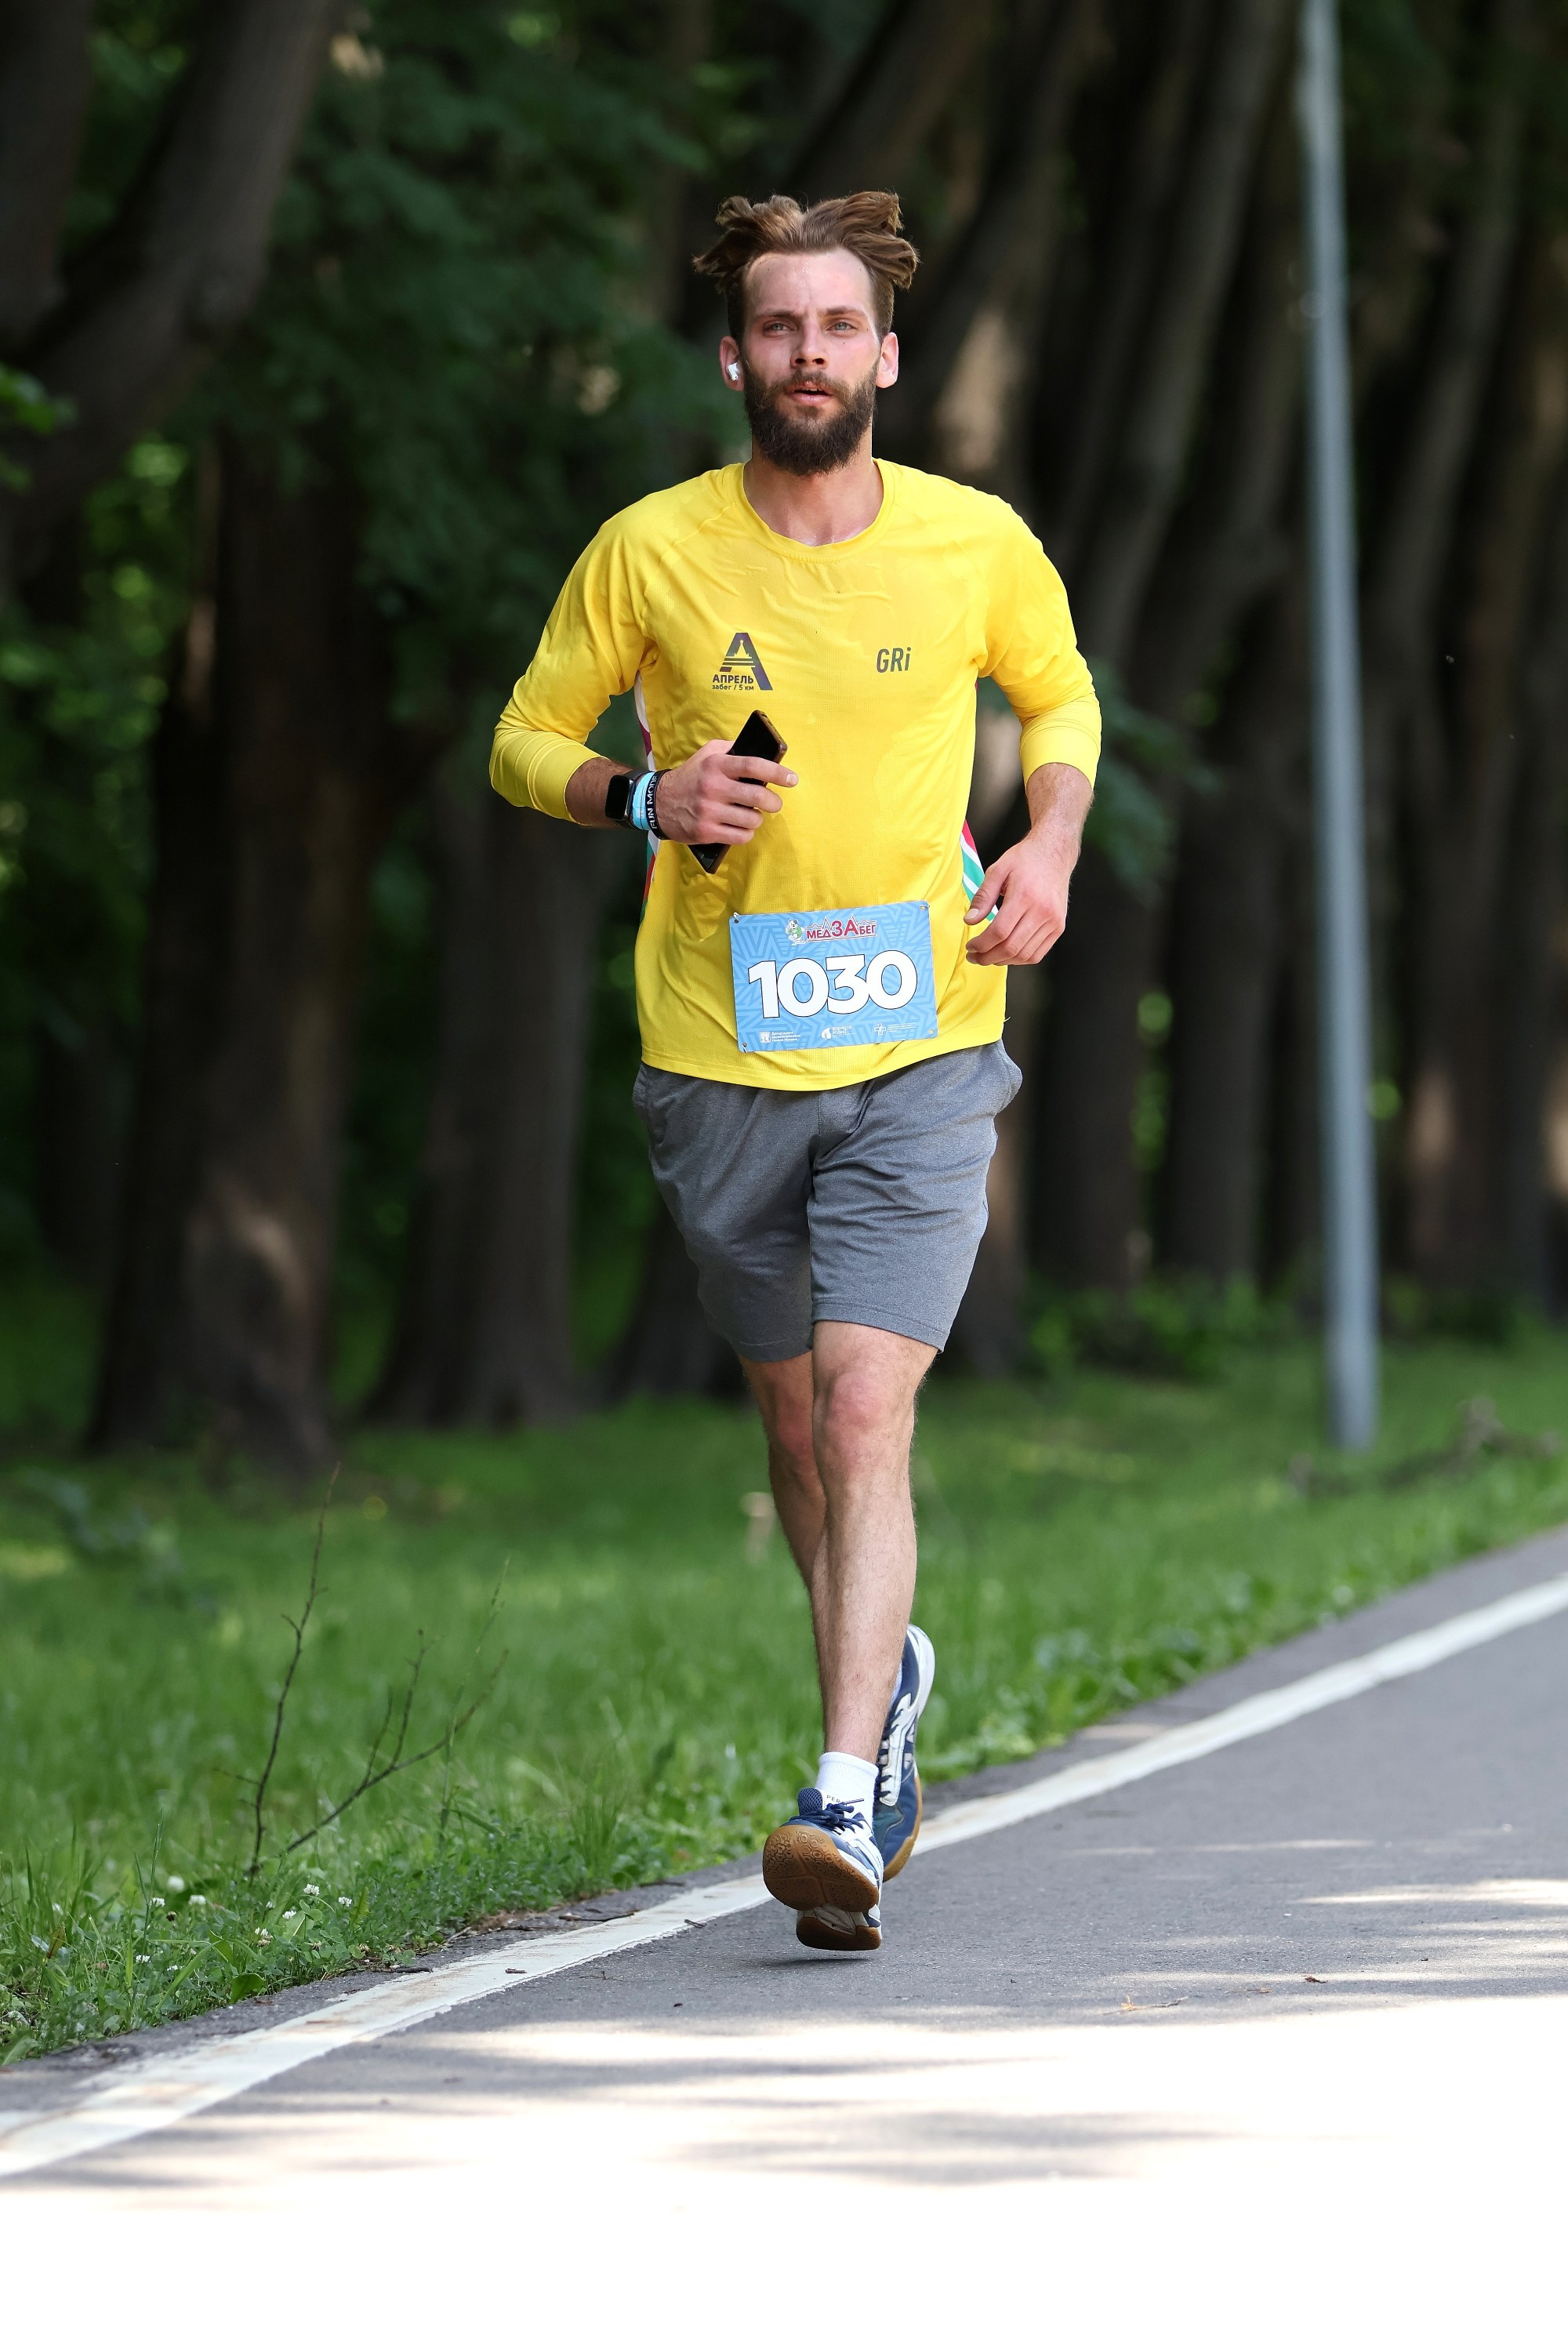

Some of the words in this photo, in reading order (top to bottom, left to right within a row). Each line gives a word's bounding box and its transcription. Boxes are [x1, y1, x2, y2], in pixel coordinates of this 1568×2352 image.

[876, 647, 912, 673] GRi
[712, 673, 753, 684] АПРЕЛЬ
[647, 808, 658, 829] FUN
[748, 949, 918, 1018] 1030
